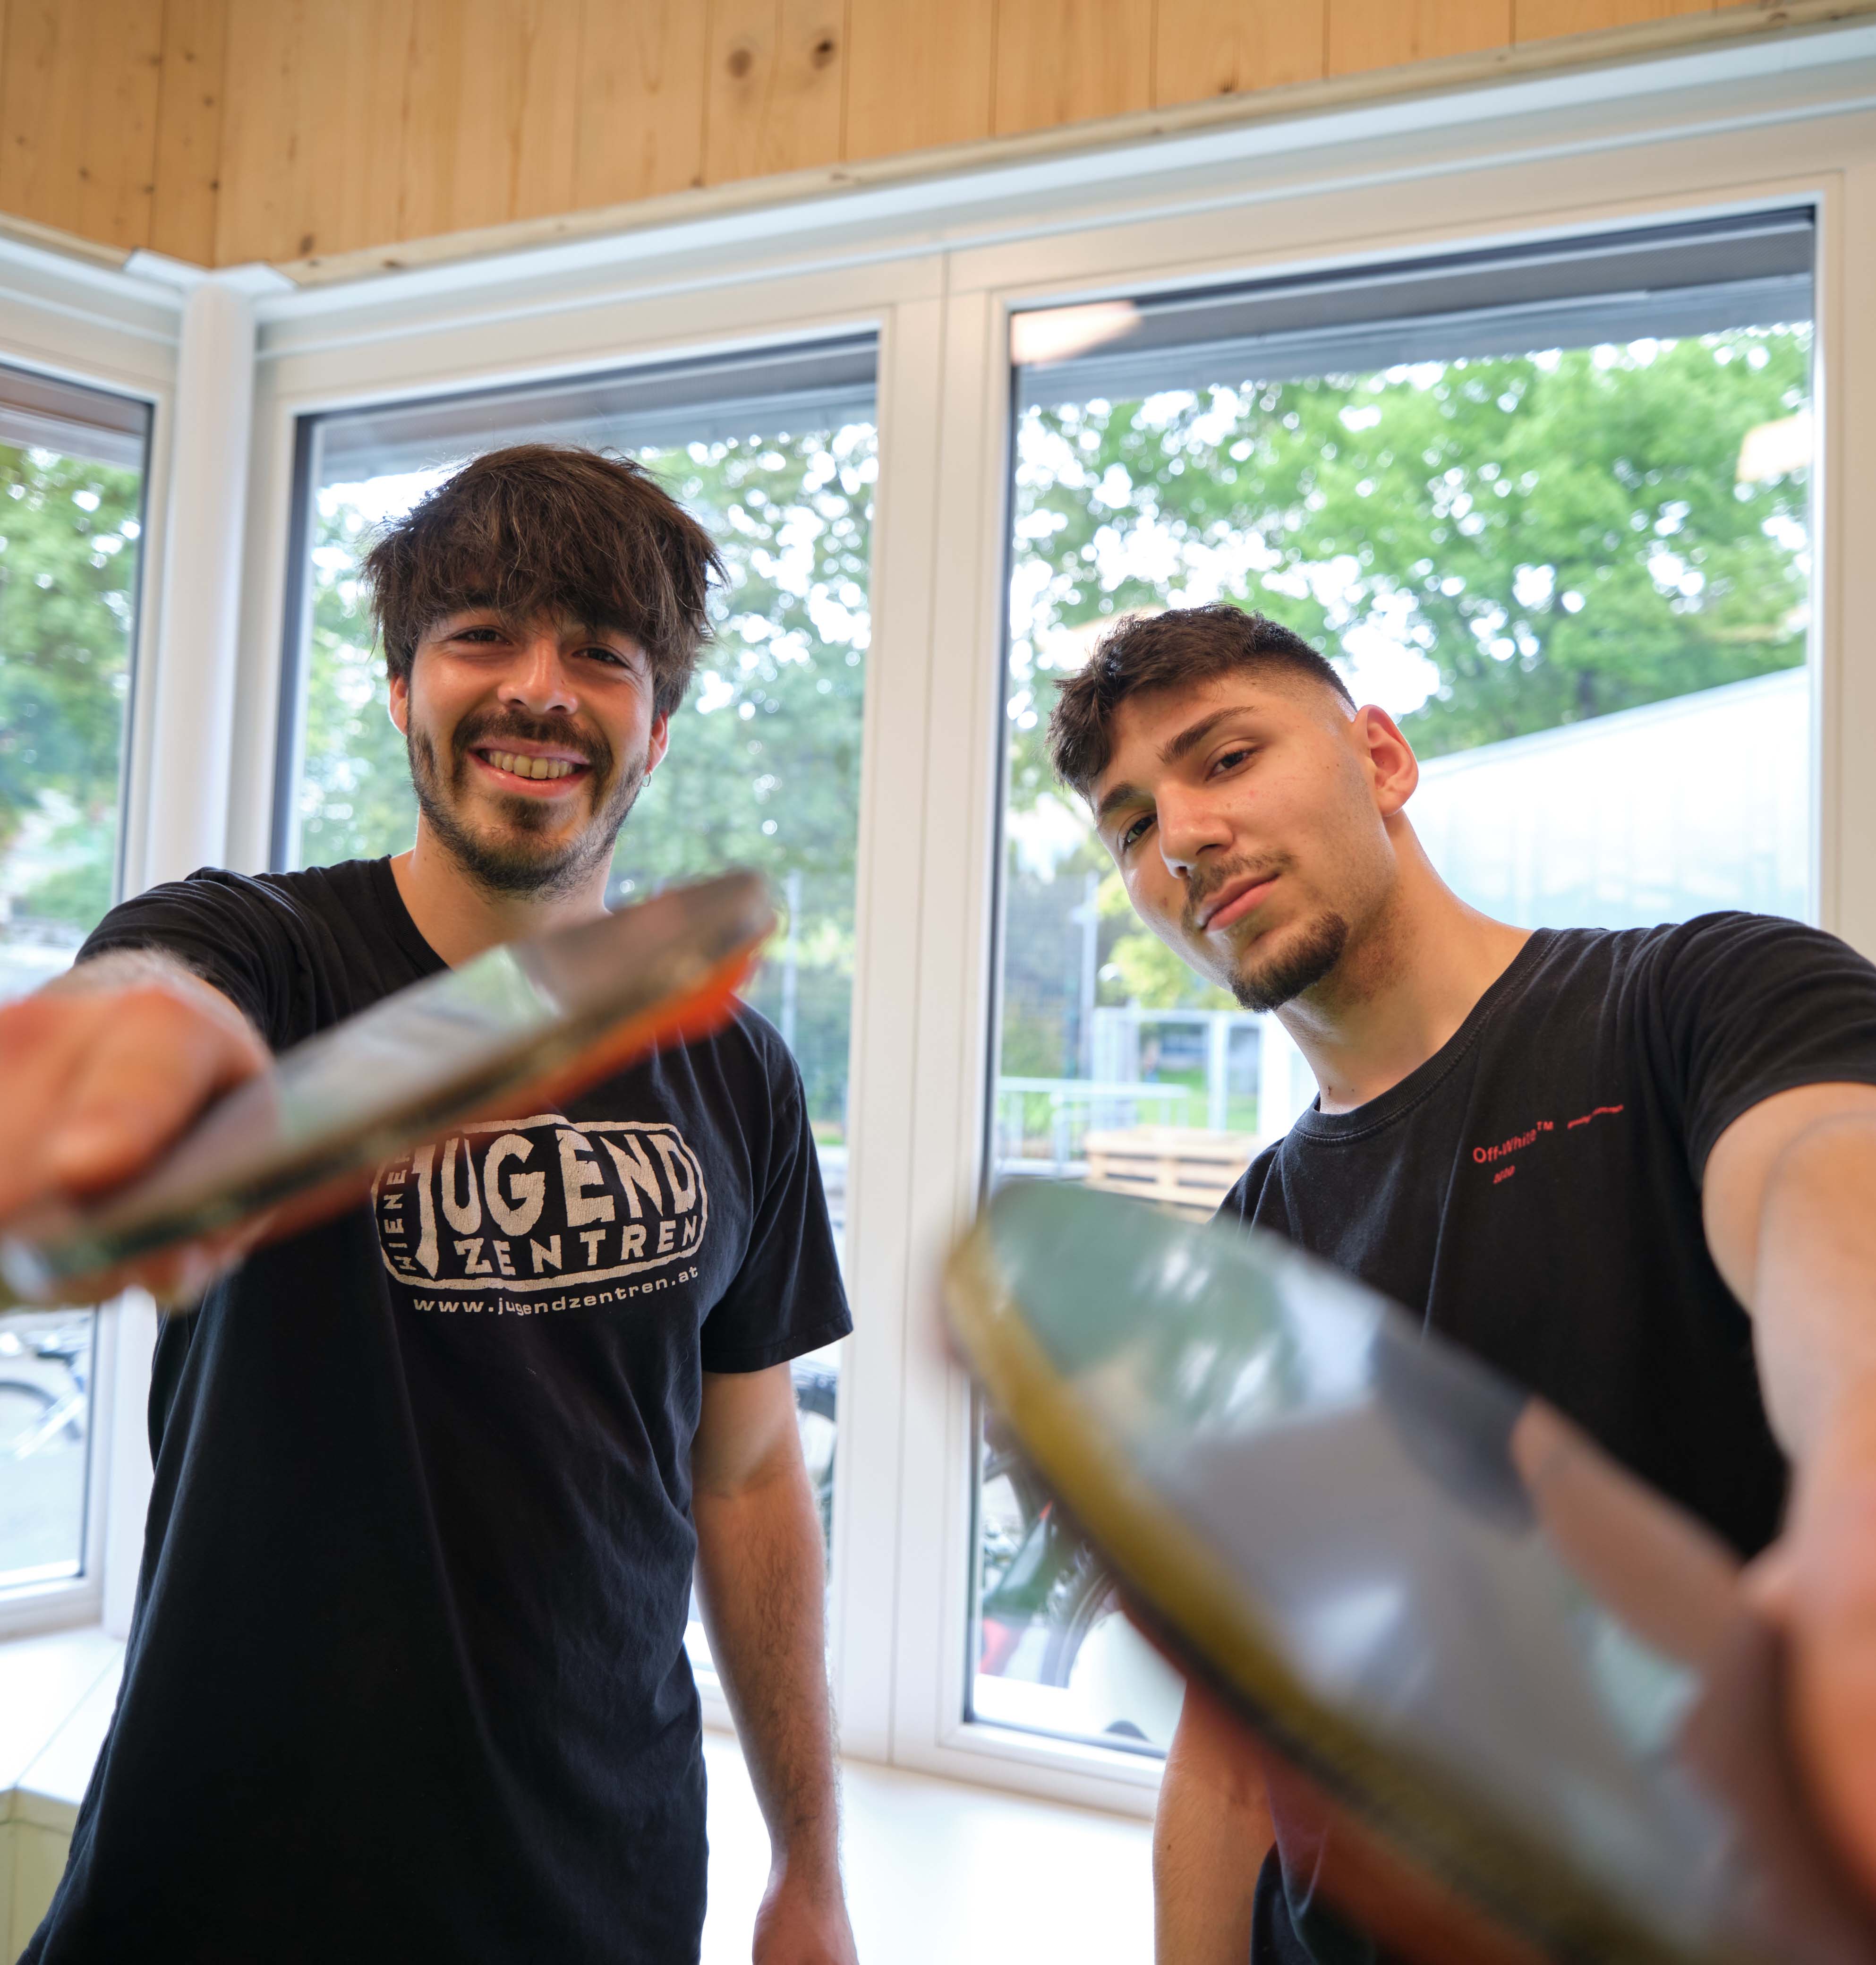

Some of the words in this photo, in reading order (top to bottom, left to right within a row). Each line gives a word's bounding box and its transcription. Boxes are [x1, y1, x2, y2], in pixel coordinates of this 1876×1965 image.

[411, 1129, 697, 1279] JUGEND
[454, 1215, 697, 1275] ZENTREN
[414, 1266, 698, 1316] www.jugendzentren.at
